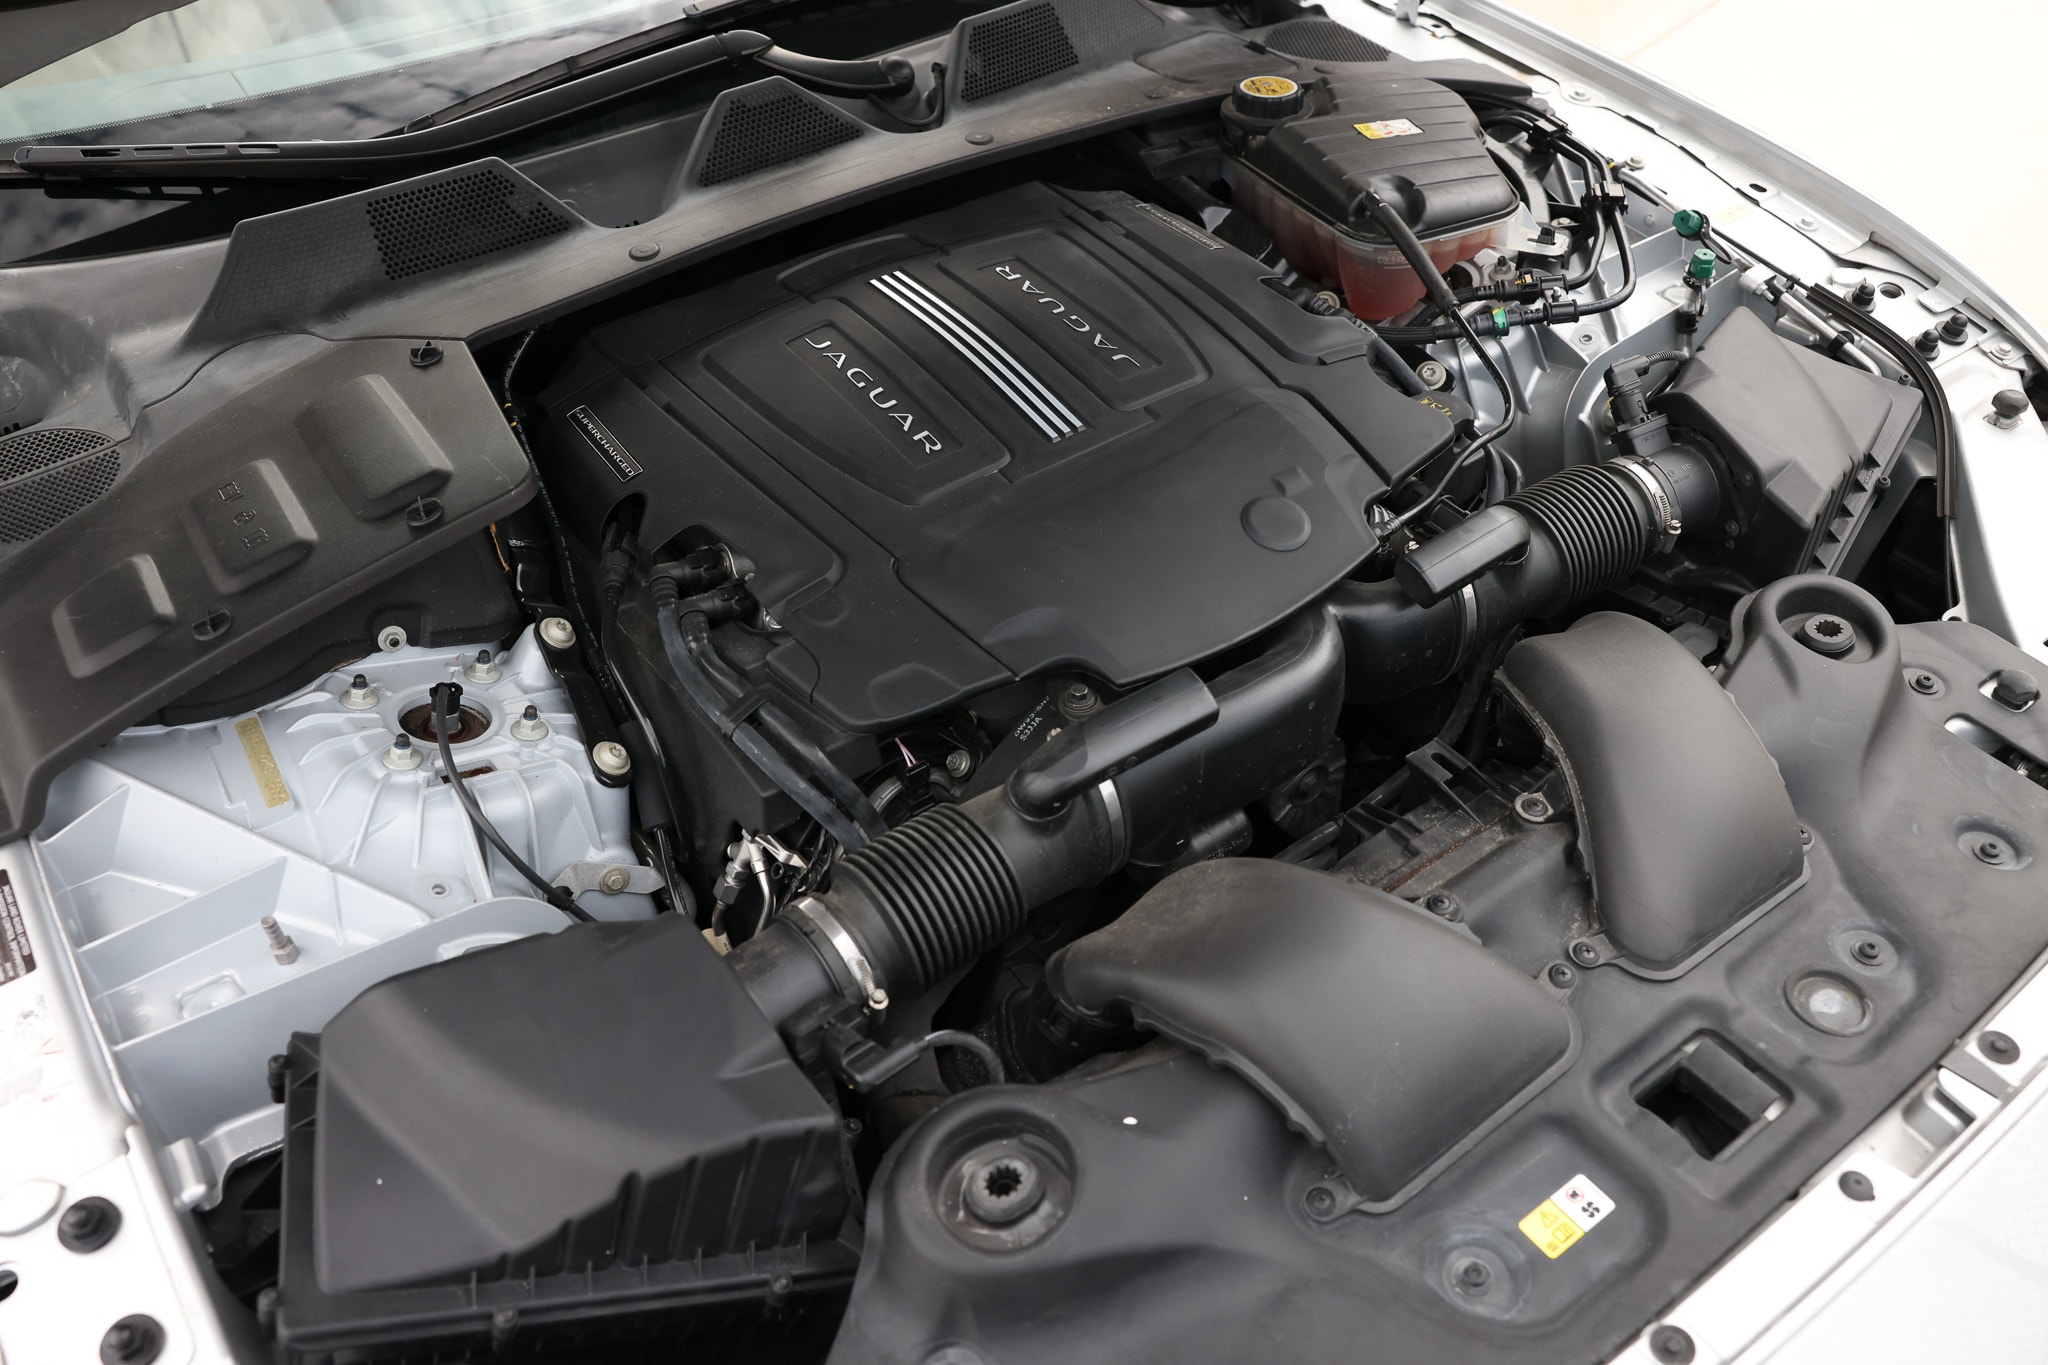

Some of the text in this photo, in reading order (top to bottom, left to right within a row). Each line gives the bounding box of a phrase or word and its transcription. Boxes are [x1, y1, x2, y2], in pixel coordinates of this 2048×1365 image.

[995, 265, 1141, 367] JAGUAR
[574, 409, 634, 476] SUPERCHARGED
[805, 337, 942, 454] JAGUAR
